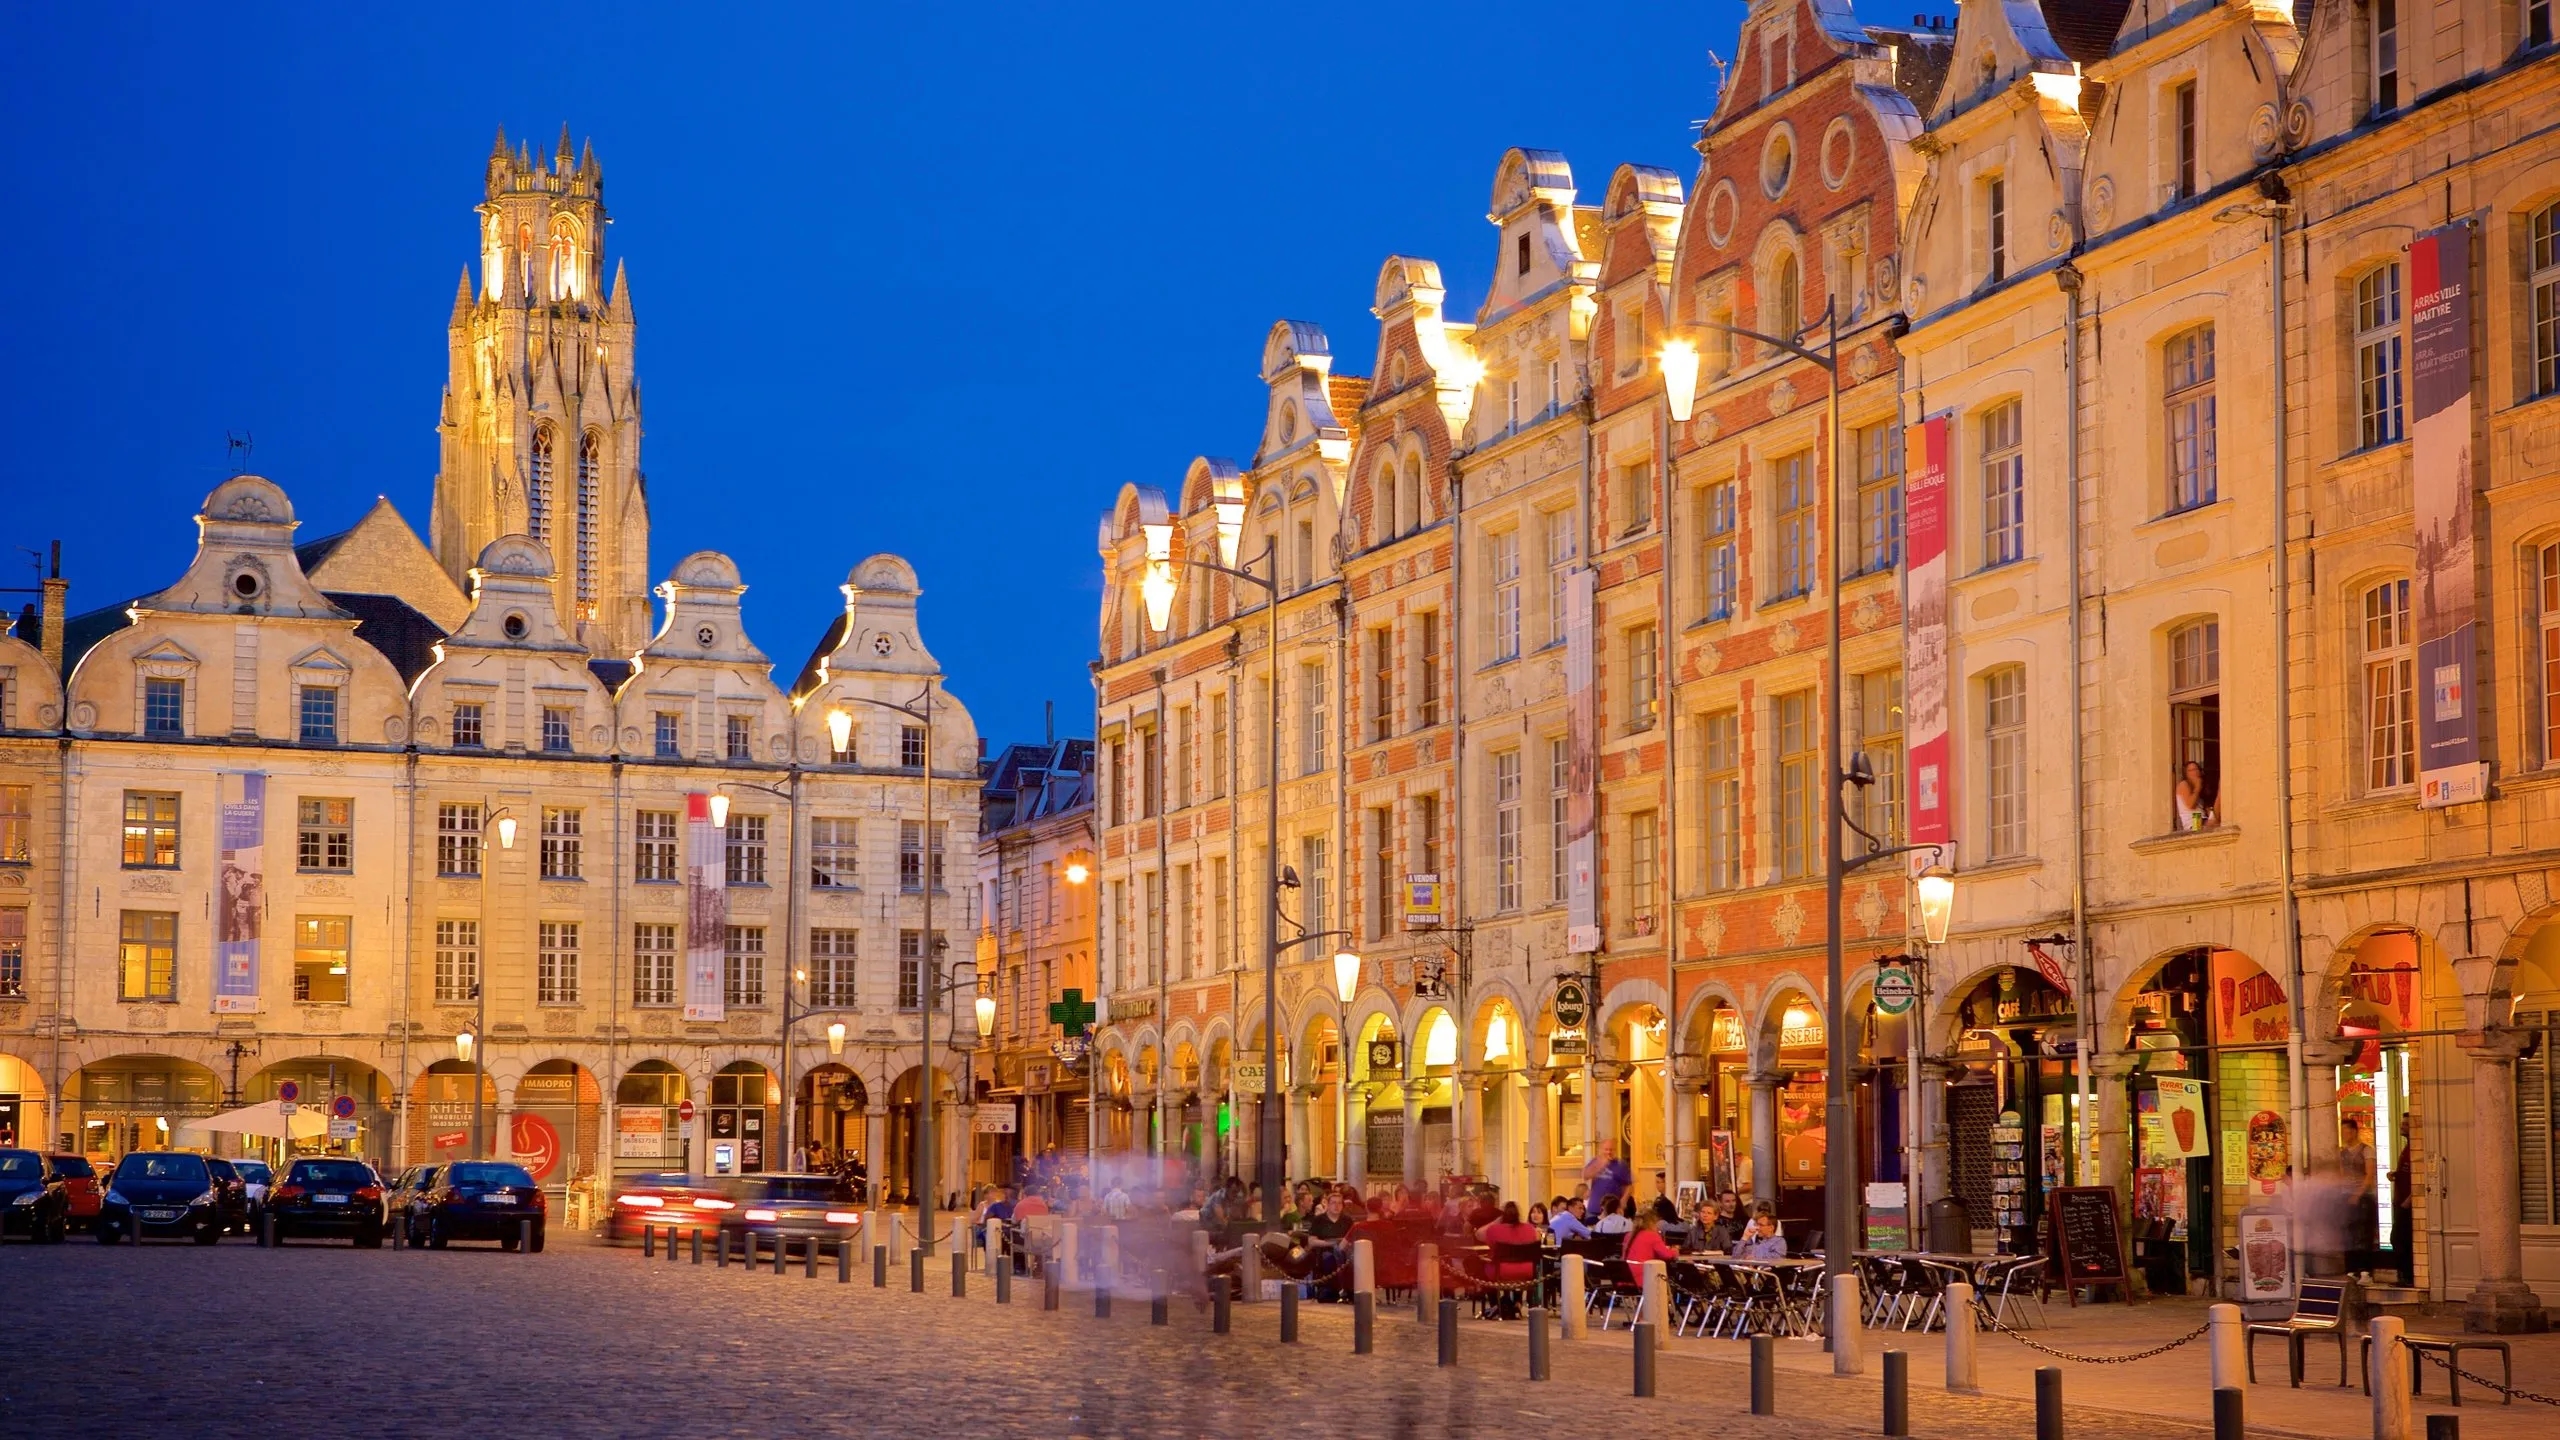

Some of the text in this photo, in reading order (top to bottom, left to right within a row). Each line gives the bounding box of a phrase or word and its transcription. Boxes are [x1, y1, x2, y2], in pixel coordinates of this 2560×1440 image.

[2413, 284, 2461, 310] ARRAS VILLE
[2414, 302, 2452, 325] MARTYRE
[1413, 874, 1438, 883] VENDRE
[1876, 987, 1911, 995] Heineken
[1998, 998, 2021, 1018] CAFÉ
[524, 1080, 572, 1088] IMMOPRO
[430, 1102, 472, 1113] KHEL
[129, 1110, 155, 1118] poisson
[173, 1109, 191, 1117] fruits
